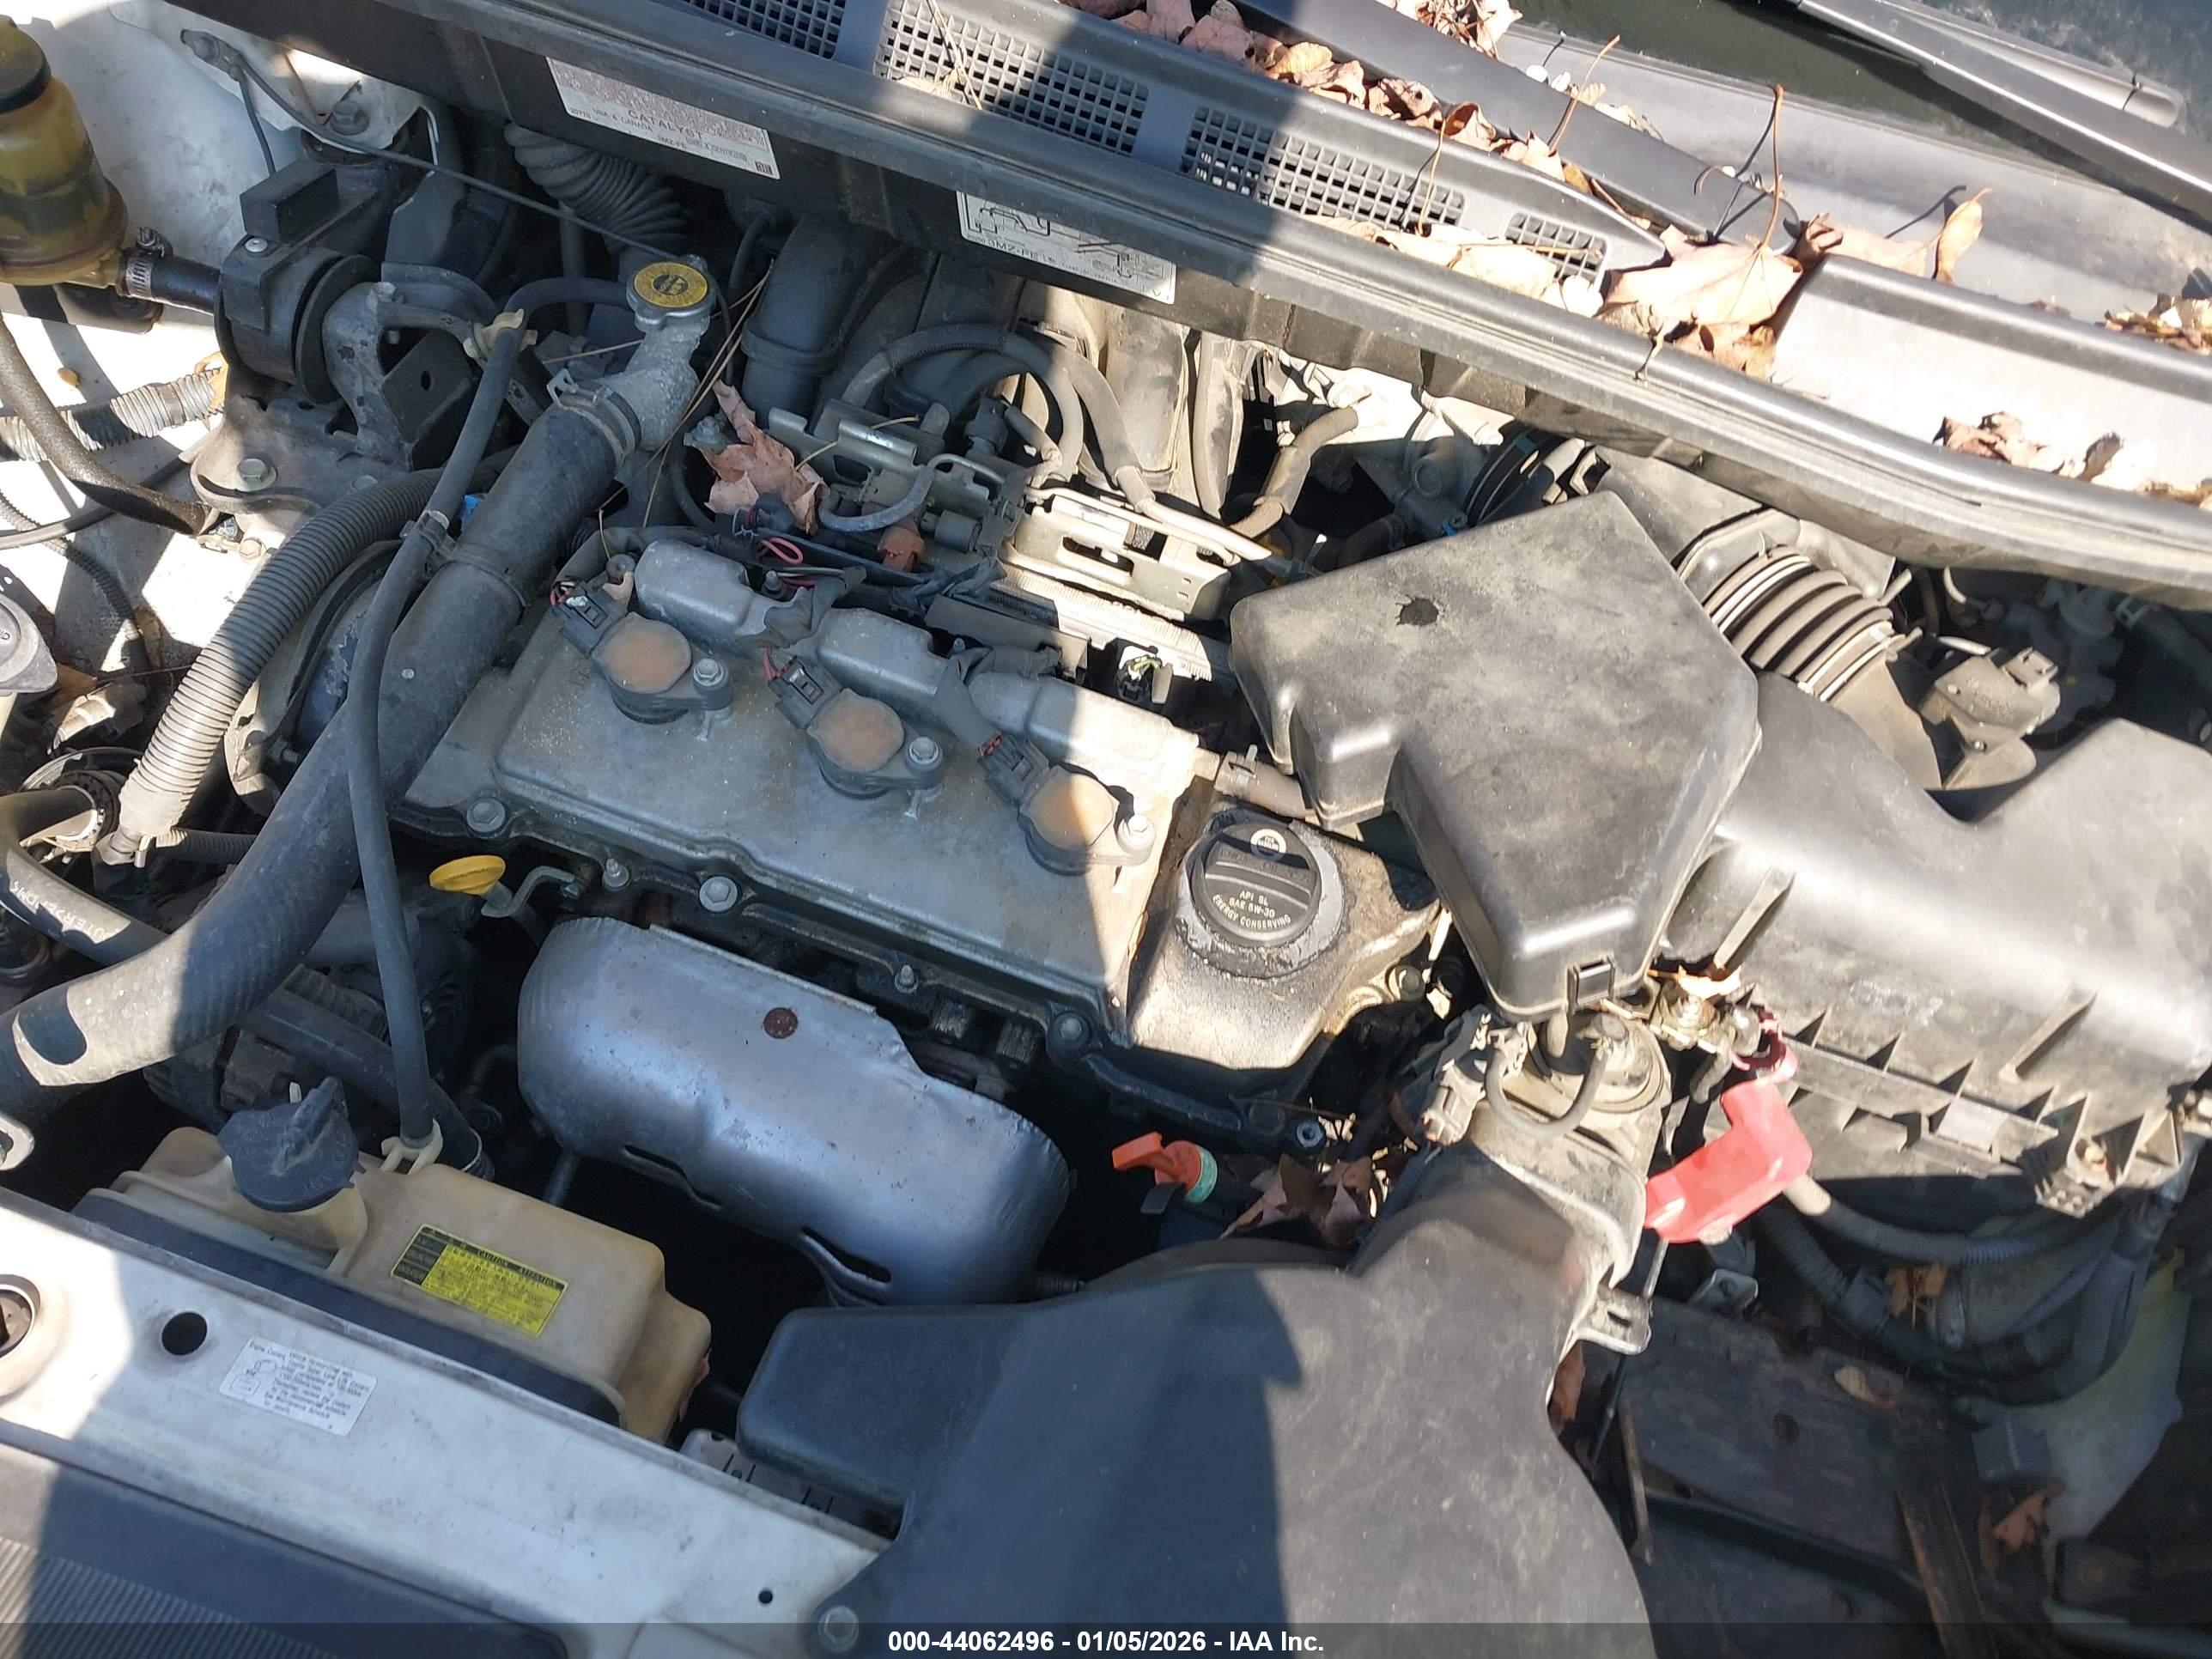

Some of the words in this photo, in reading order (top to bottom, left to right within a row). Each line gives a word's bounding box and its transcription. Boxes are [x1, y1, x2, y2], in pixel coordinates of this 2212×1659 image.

[628, 109, 702, 140] CATALYST
[1229, 896, 1246, 910] SAE
[1248, 902, 1276, 920] 5W-30
[1239, 890, 1255, 901] API
[1212, 894, 1239, 921] ENERGY
[1239, 914, 1291, 930] CONSERVING
